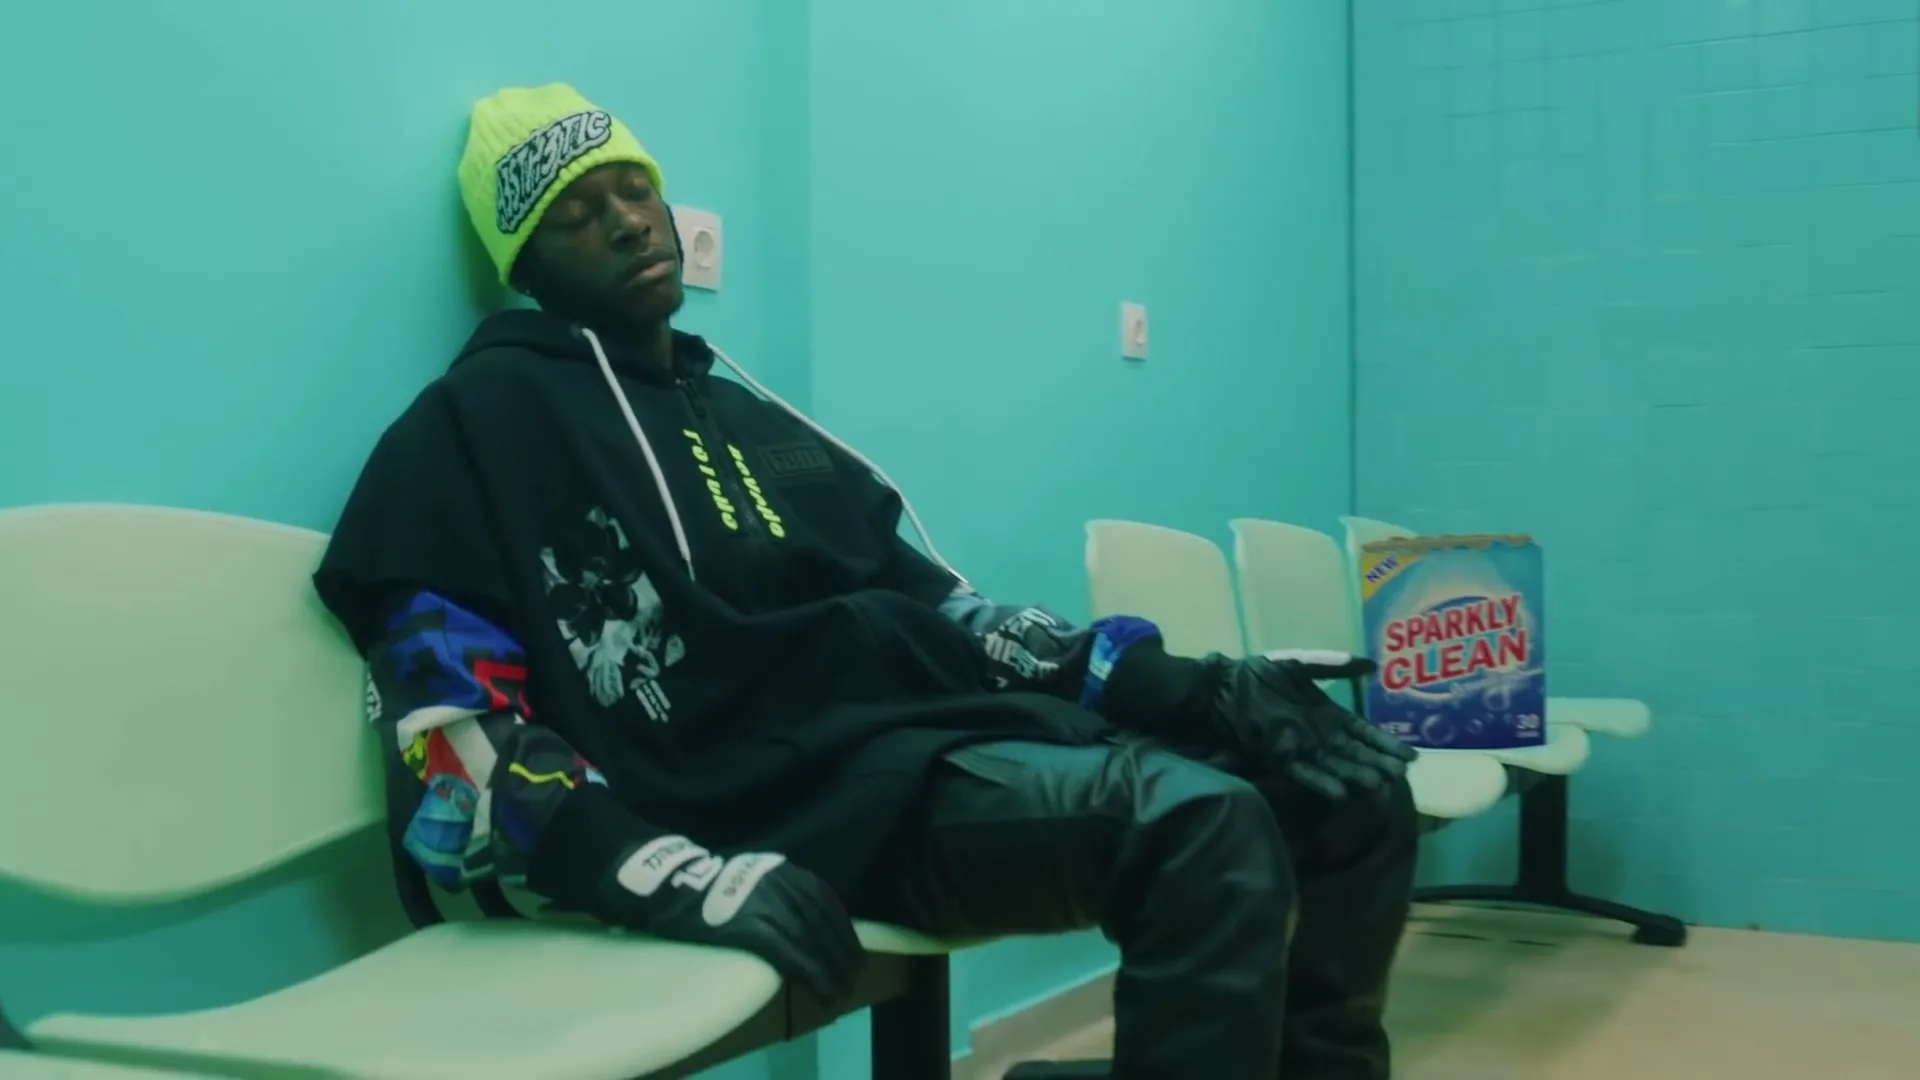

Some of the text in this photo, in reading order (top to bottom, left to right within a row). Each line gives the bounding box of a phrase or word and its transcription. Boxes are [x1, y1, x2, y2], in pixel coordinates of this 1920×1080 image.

[1365, 555, 1398, 583] NEW
[1384, 593, 1521, 653] SPARKLY
[1382, 630, 1526, 692] CLEAN
